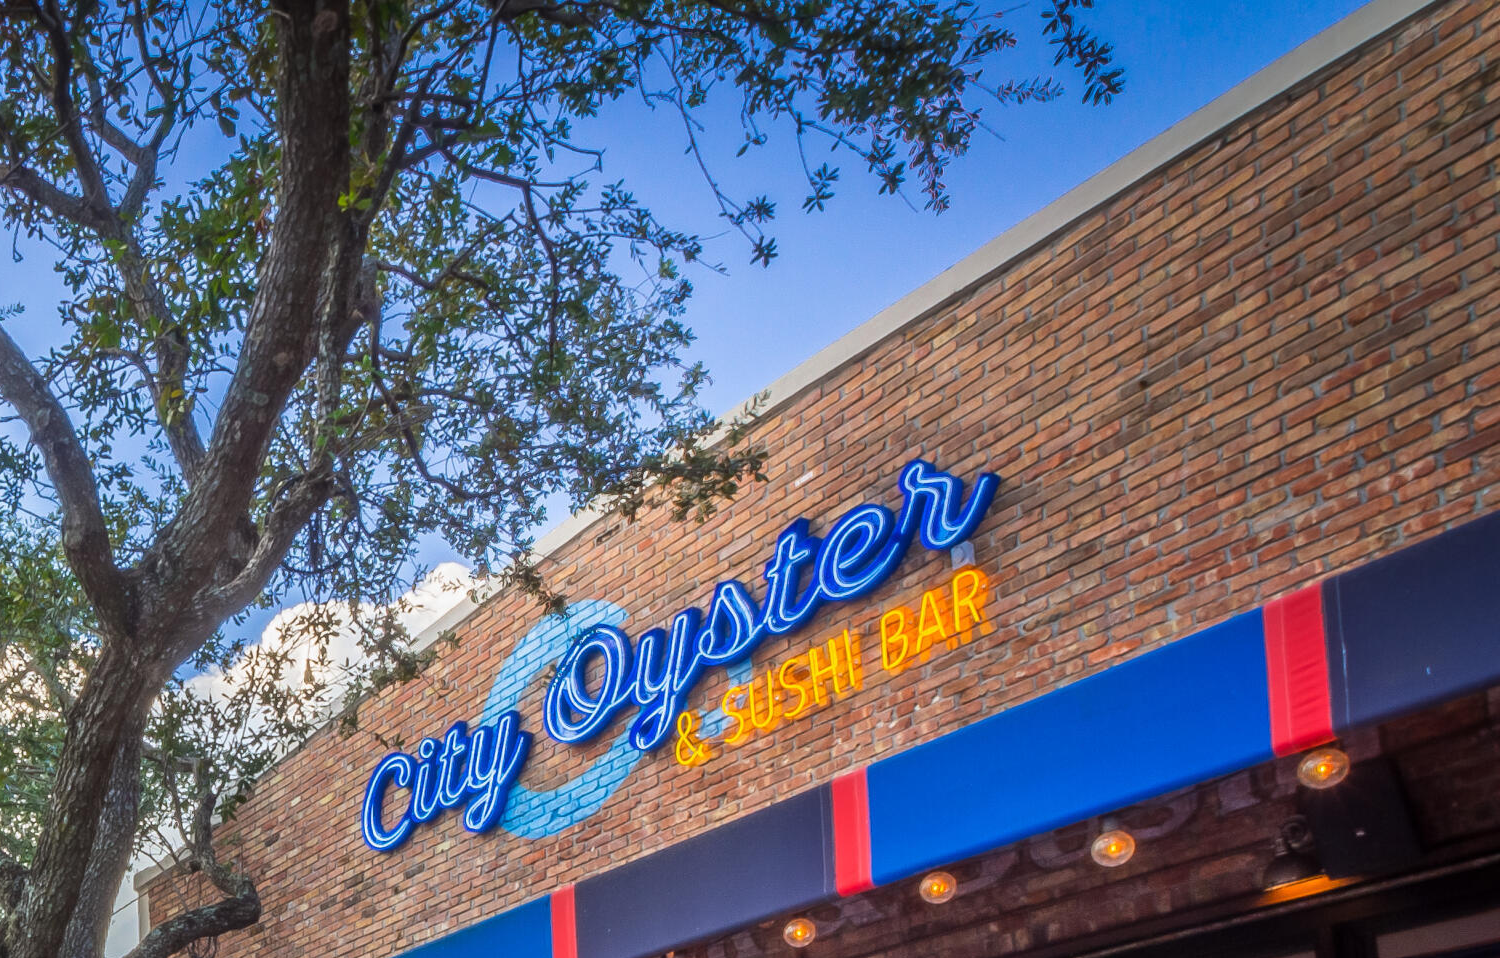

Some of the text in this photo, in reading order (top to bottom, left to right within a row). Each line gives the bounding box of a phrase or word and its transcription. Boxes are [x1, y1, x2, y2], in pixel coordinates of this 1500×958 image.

[362, 457, 1001, 852] City Oyster
[674, 565, 994, 768] & SUSHI BAR
